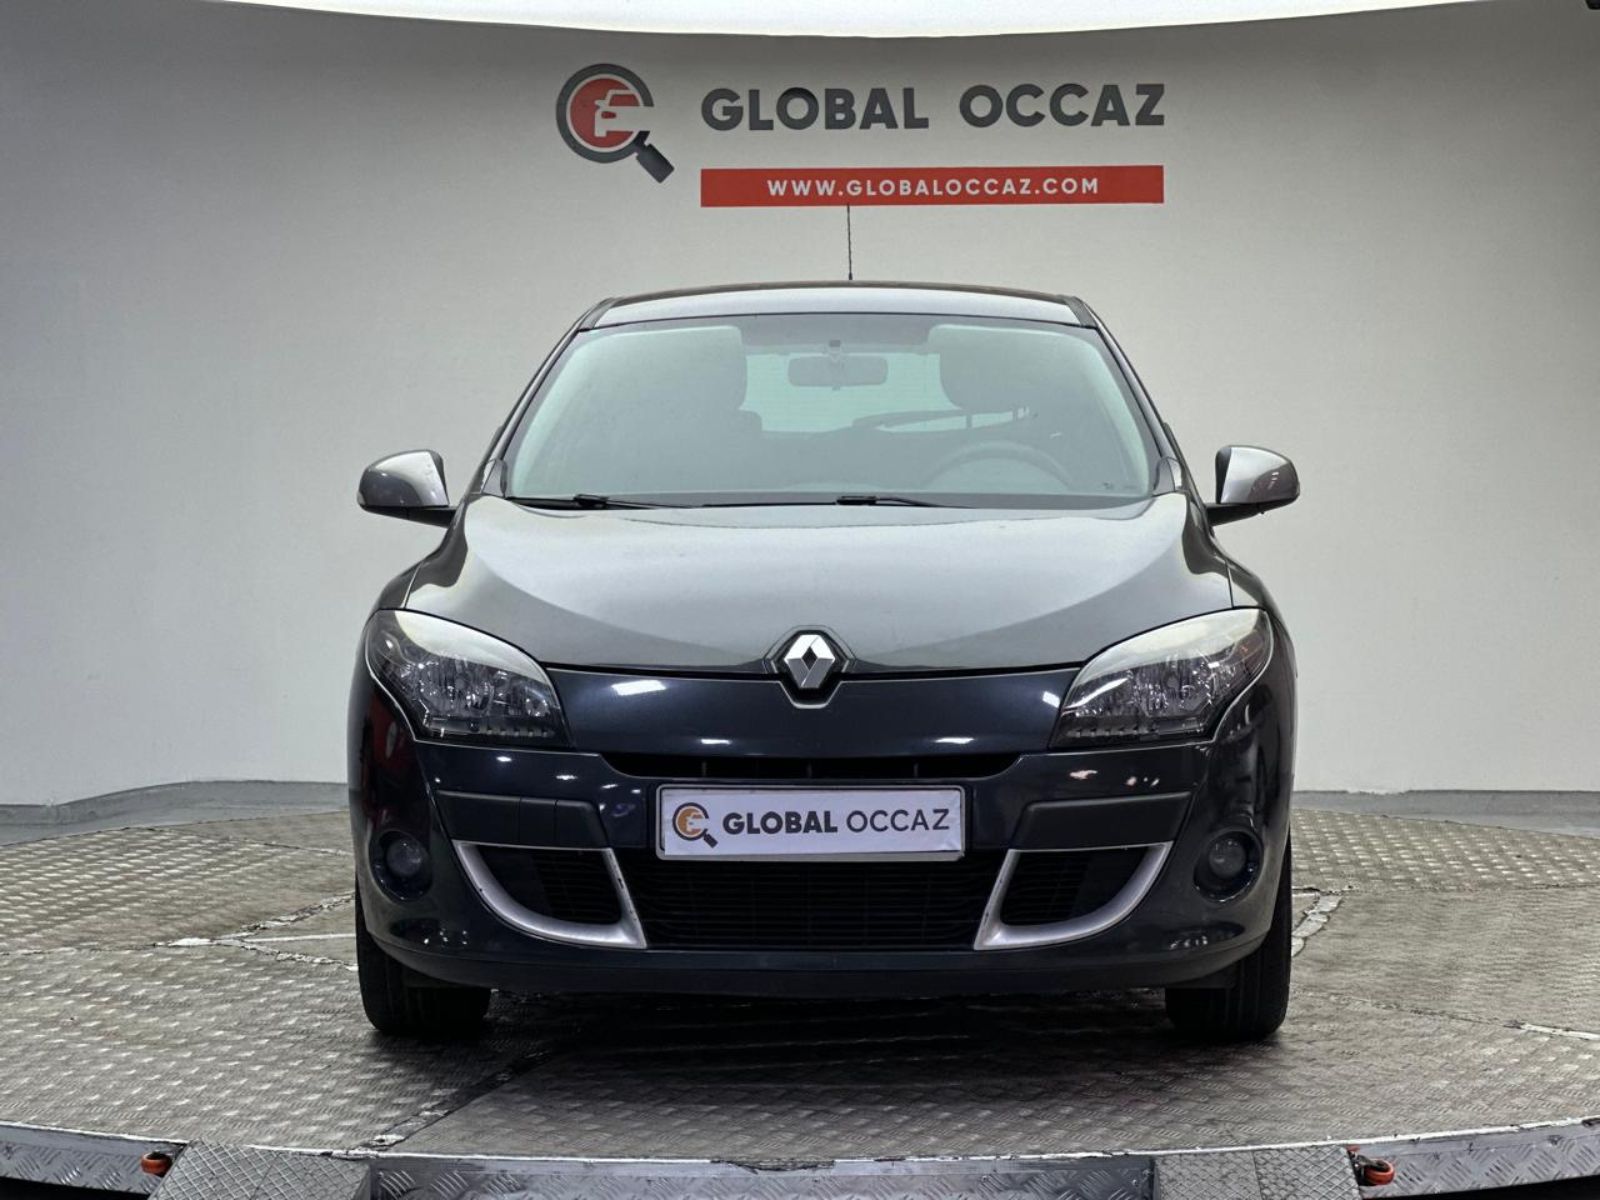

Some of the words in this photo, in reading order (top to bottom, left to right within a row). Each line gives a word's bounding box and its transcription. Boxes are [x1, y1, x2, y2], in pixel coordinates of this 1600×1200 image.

[701, 86, 928, 131] GLOBAL
[959, 83, 1165, 127] OCCAZ
[767, 177, 1099, 197] WWW.GLOBALOCCAZ.COM
[723, 811, 838, 835] GLOBAL
[846, 809, 950, 833] OCCAZ
